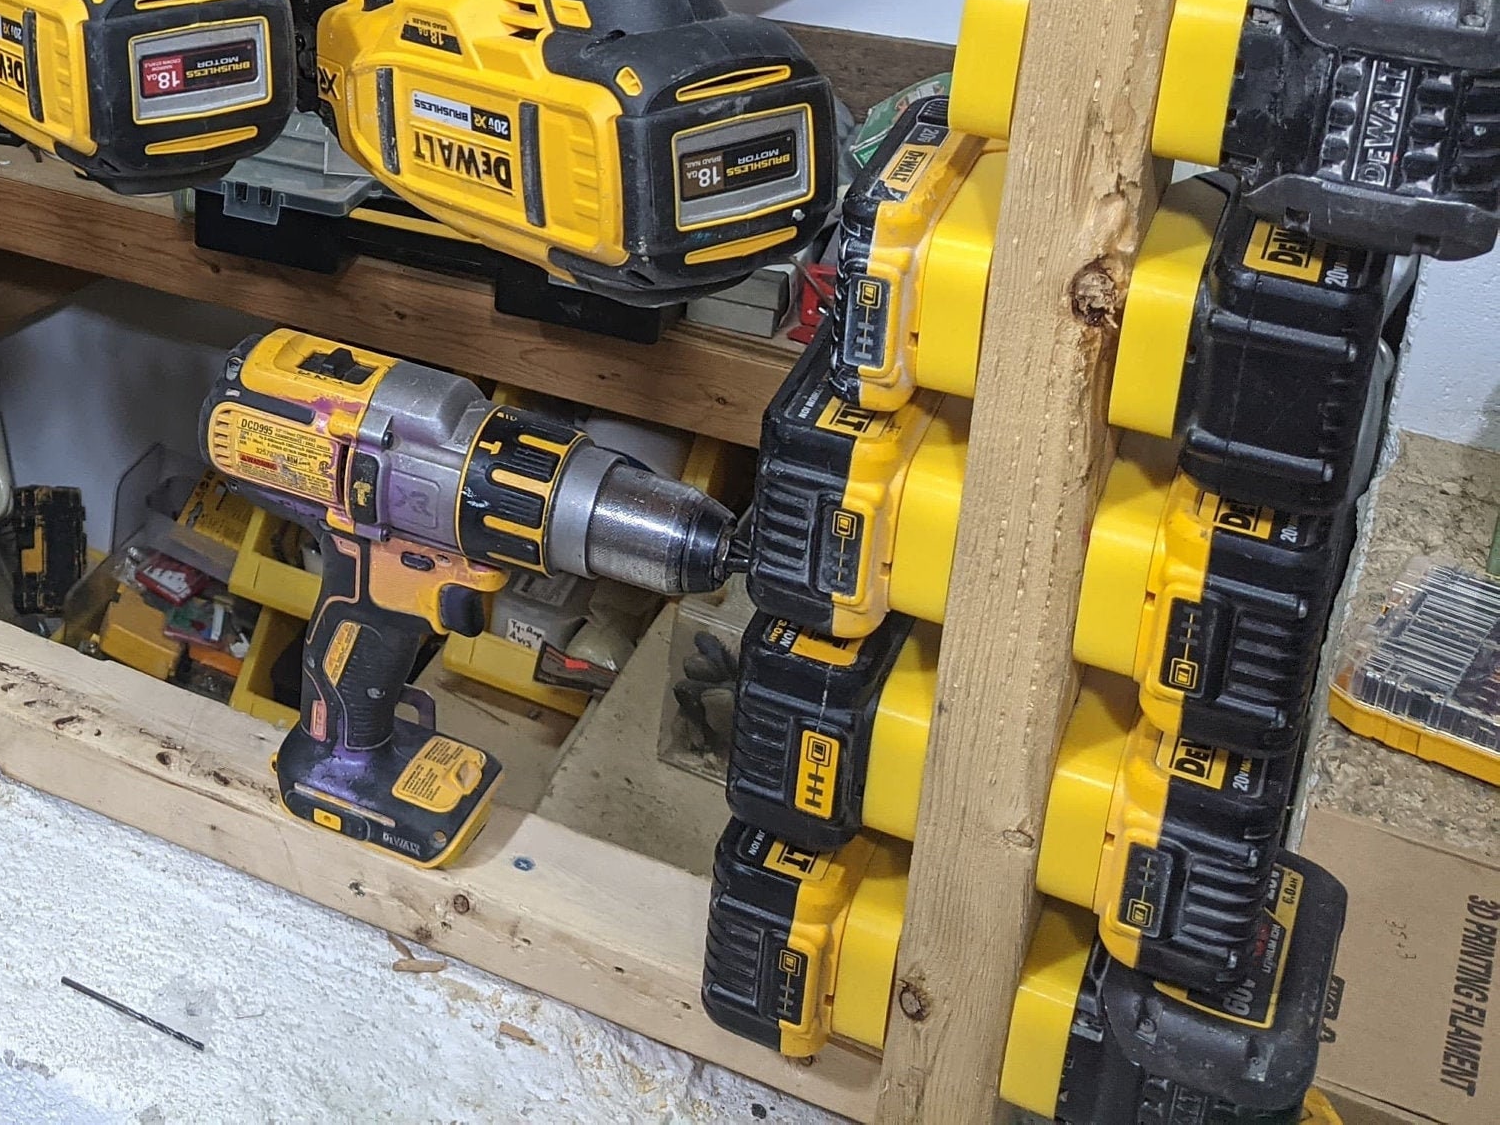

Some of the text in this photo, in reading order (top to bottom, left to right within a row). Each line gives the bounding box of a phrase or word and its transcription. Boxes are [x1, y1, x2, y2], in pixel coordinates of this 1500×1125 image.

[185, 60, 251, 79] BRUSHLESS
[196, 55, 239, 69] MOTOR
[414, 98, 469, 122] BRUSHLESS
[725, 153, 790, 176] BRUSHLESS
[737, 148, 779, 165] MOTOR
[1267, 225, 1307, 268] DEW
[241, 418, 274, 435] DCD995
[1452, 918, 1498, 1003] PRINTING
[1440, 999, 1487, 1098] FILAMENT
